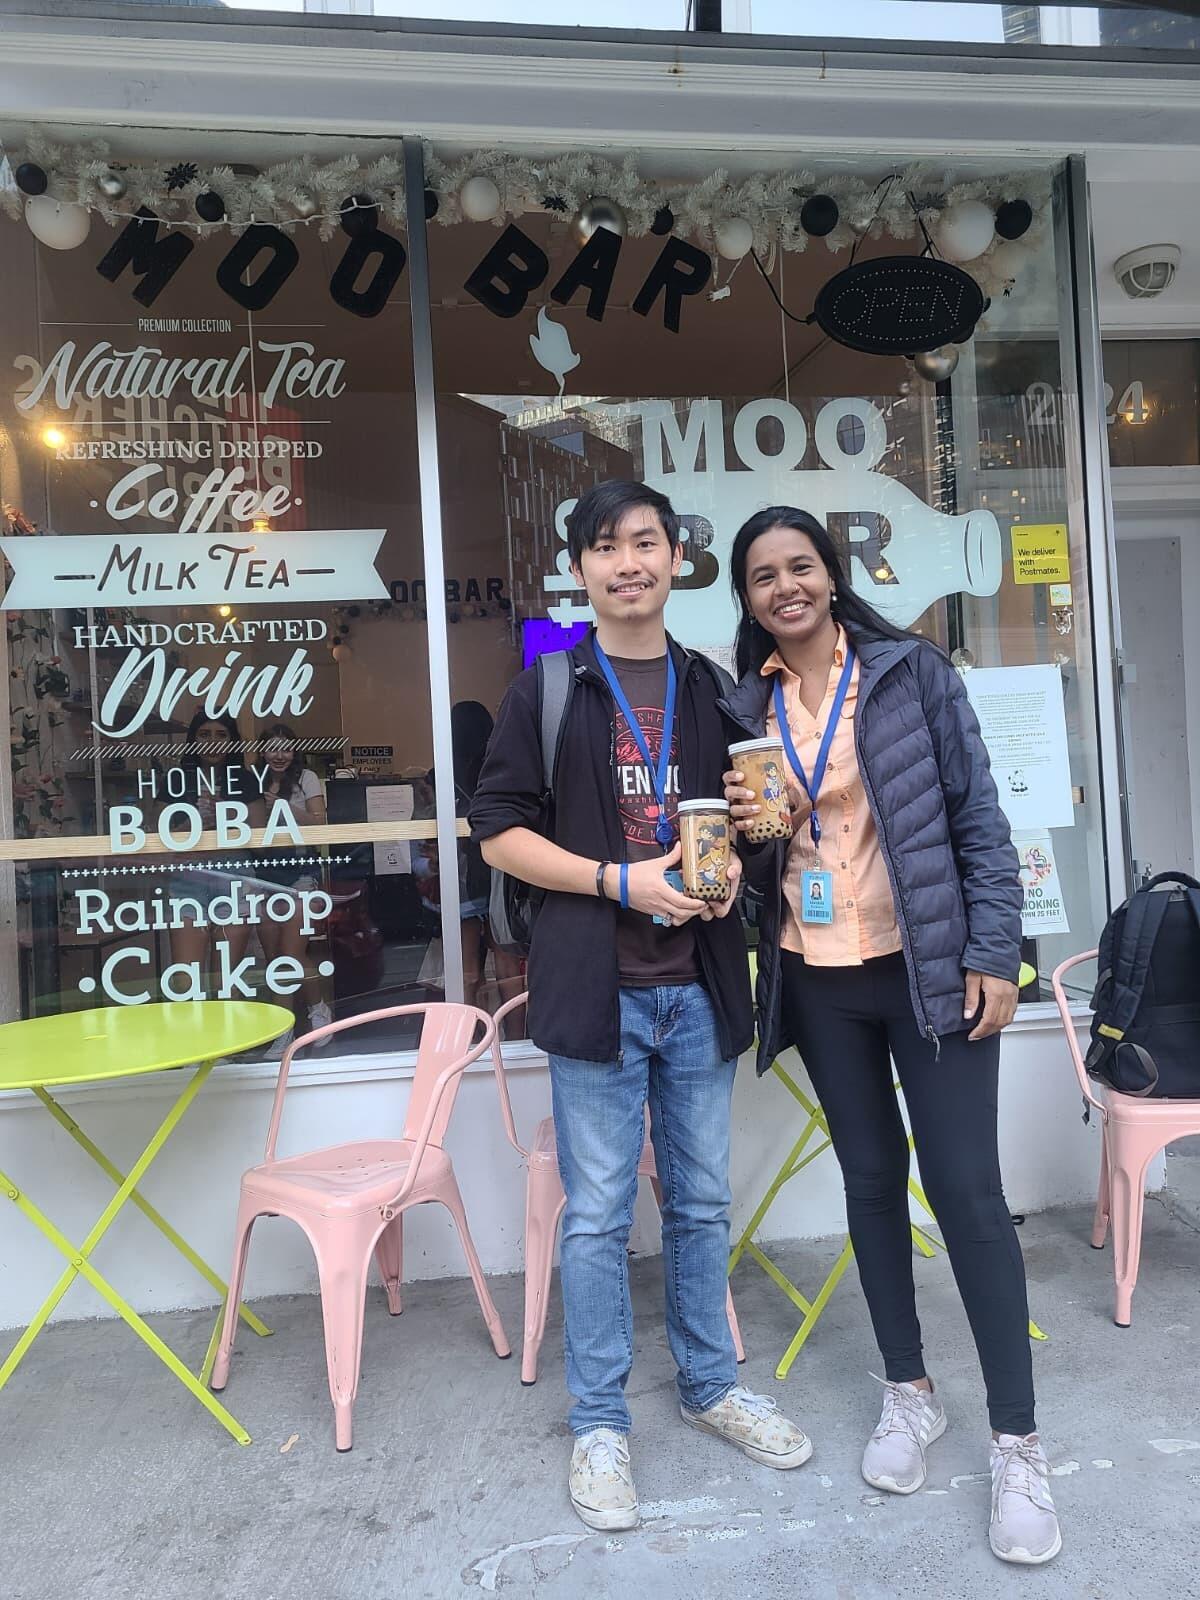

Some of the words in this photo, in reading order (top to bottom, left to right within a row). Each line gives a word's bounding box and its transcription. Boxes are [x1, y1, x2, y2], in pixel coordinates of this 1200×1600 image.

[96, 205, 407, 318] MOO
[463, 223, 712, 334] BAR
[832, 285, 965, 325] OPEN
[138, 318, 180, 333] PREMIUM
[182, 318, 232, 333] COLLECTION
[17, 340, 250, 411] Natural
[258, 340, 348, 410] Tea
[56, 440, 213, 460] REFRESHING
[219, 440, 323, 459] DRIPPED
[641, 396, 888, 474] MOO
[106, 463, 292, 533] Coffee
[208, 544, 291, 592] TEA
[1017, 548, 1031, 556] We
[1032, 547, 1056, 556] deliver
[1019, 568, 1061, 576] Postmates.
[73, 618, 328, 649] HANDCRAFTED
[91, 648, 315, 739] Drink
[352, 757, 392, 765] EMPLOYEES
[353, 746, 390, 755] NOTICE
[138, 763, 271, 800] HONEY
[109, 798, 305, 854] BOBA
[74, 880, 333, 936] Raindrop
[1021, 898, 1060, 911] MOKING
[1027, 887, 1044, 898] NO
[1046, 909, 1060, 917] FEET
[101, 941, 305, 1006] Cake
